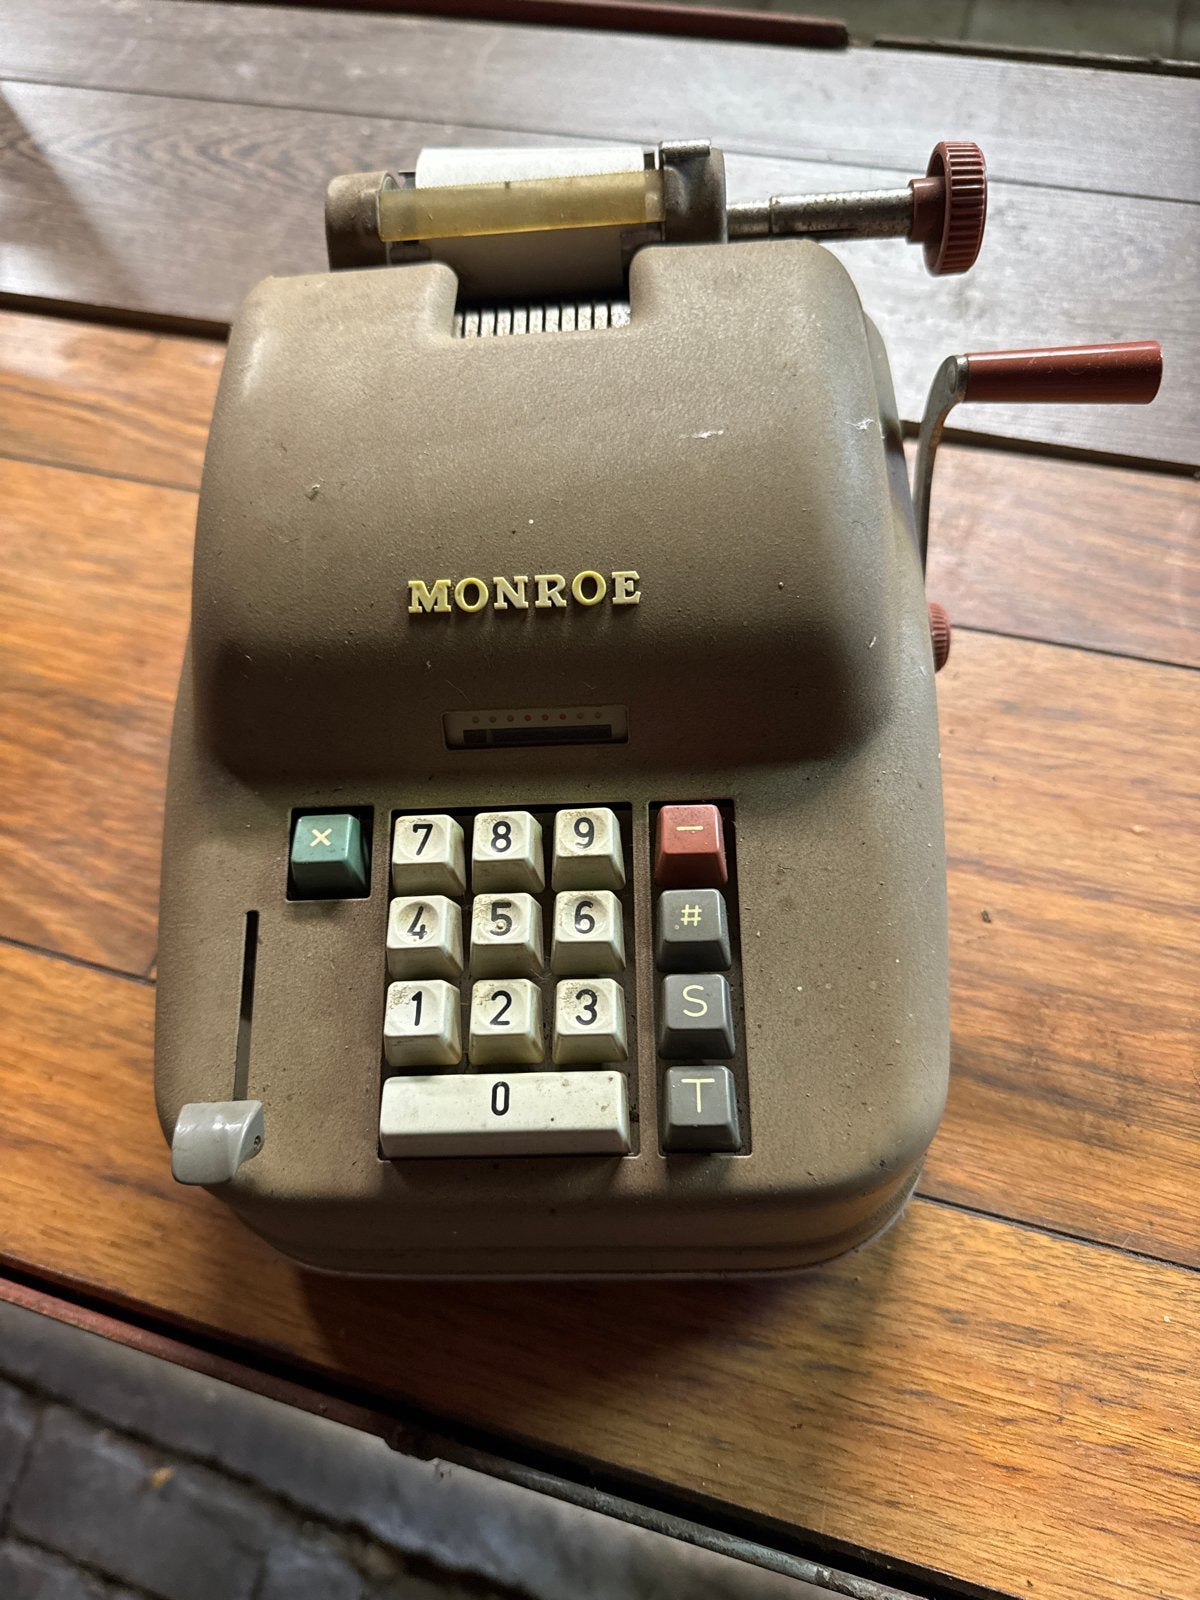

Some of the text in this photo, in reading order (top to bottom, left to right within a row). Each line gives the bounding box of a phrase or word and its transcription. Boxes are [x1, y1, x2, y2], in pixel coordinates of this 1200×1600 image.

[408, 570, 641, 613] MONROE
[412, 823, 433, 856] 7
[490, 820, 512, 853] 8
[573, 817, 595, 849] 9
[408, 906, 428, 940] 4
[490, 902, 512, 936] 5
[574, 900, 595, 934] 6
[680, 904, 702, 927] #
[411, 990, 423, 1026] 1
[490, 990, 510, 1026] 2
[575, 988, 598, 1026] 3
[682, 984, 708, 1018] S
[491, 1081, 510, 1116] 0
[681, 1078, 715, 1113] T
